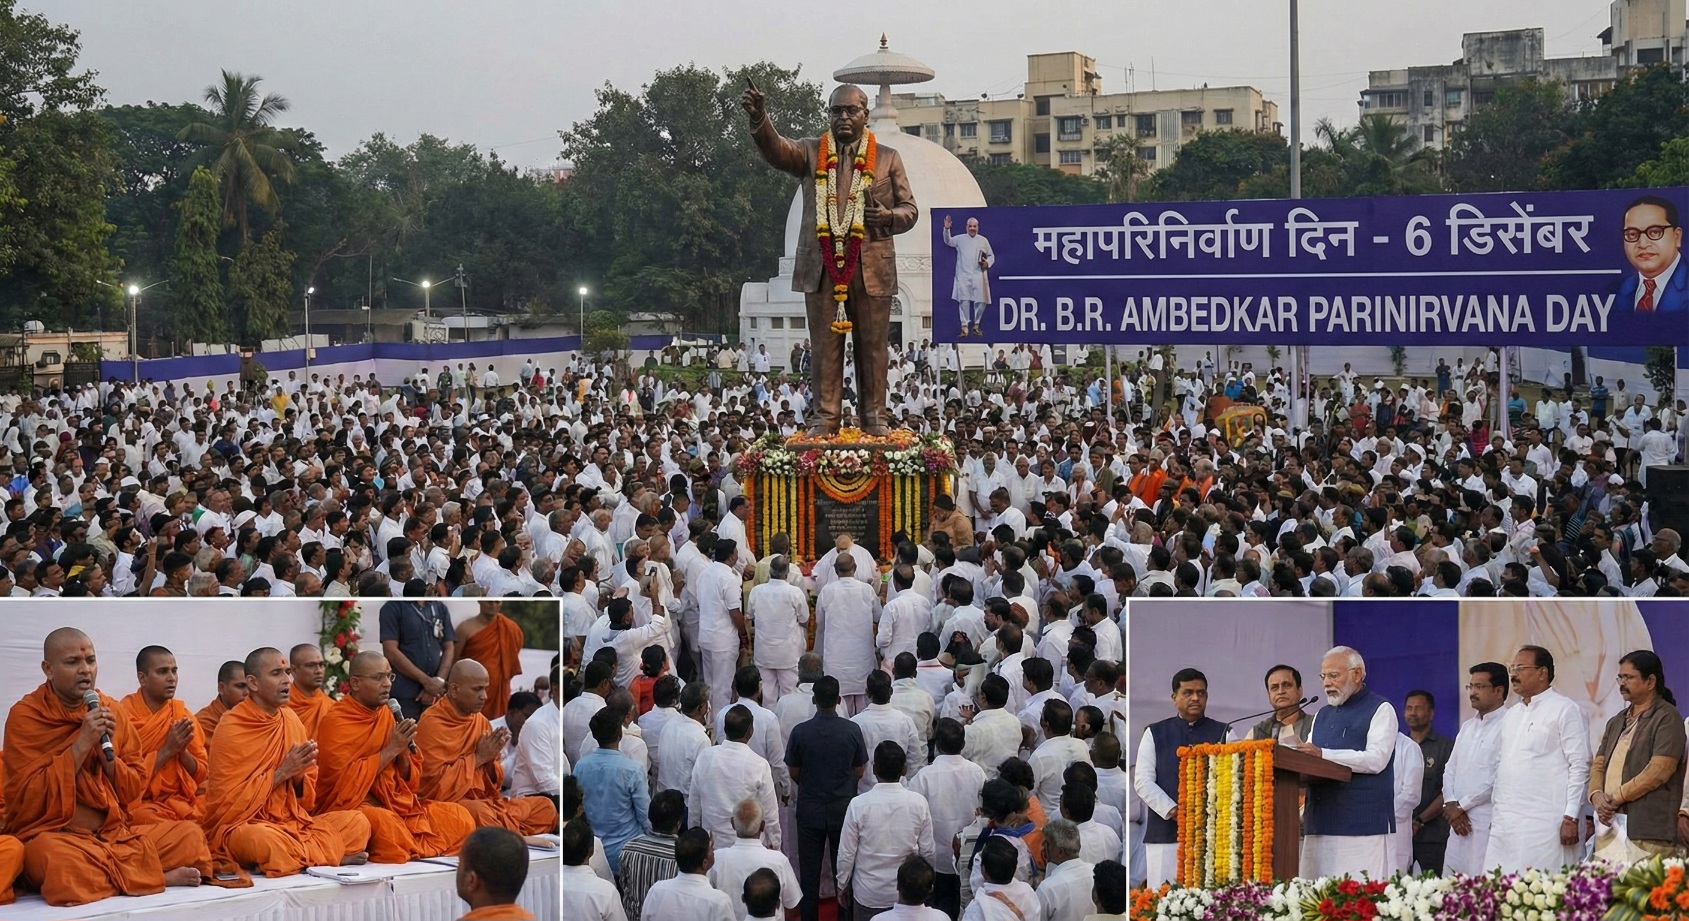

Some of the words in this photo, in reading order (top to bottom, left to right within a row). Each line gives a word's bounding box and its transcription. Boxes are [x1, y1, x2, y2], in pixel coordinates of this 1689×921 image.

[1032, 208, 1274, 265] महापरिनिर्वाण
[1284, 207, 1359, 261] दिन
[1373, 236, 1389, 244] -
[1405, 215, 1432, 257] 6
[1445, 200, 1594, 255] डिसेंबर
[999, 297, 1046, 331] DR.
[1056, 296, 1112, 332] B.R.
[1120, 296, 1298, 332] AMBEDKAR
[1309, 294, 1536, 333] PARINIRVANA
[1546, 293, 1616, 333] DAY
